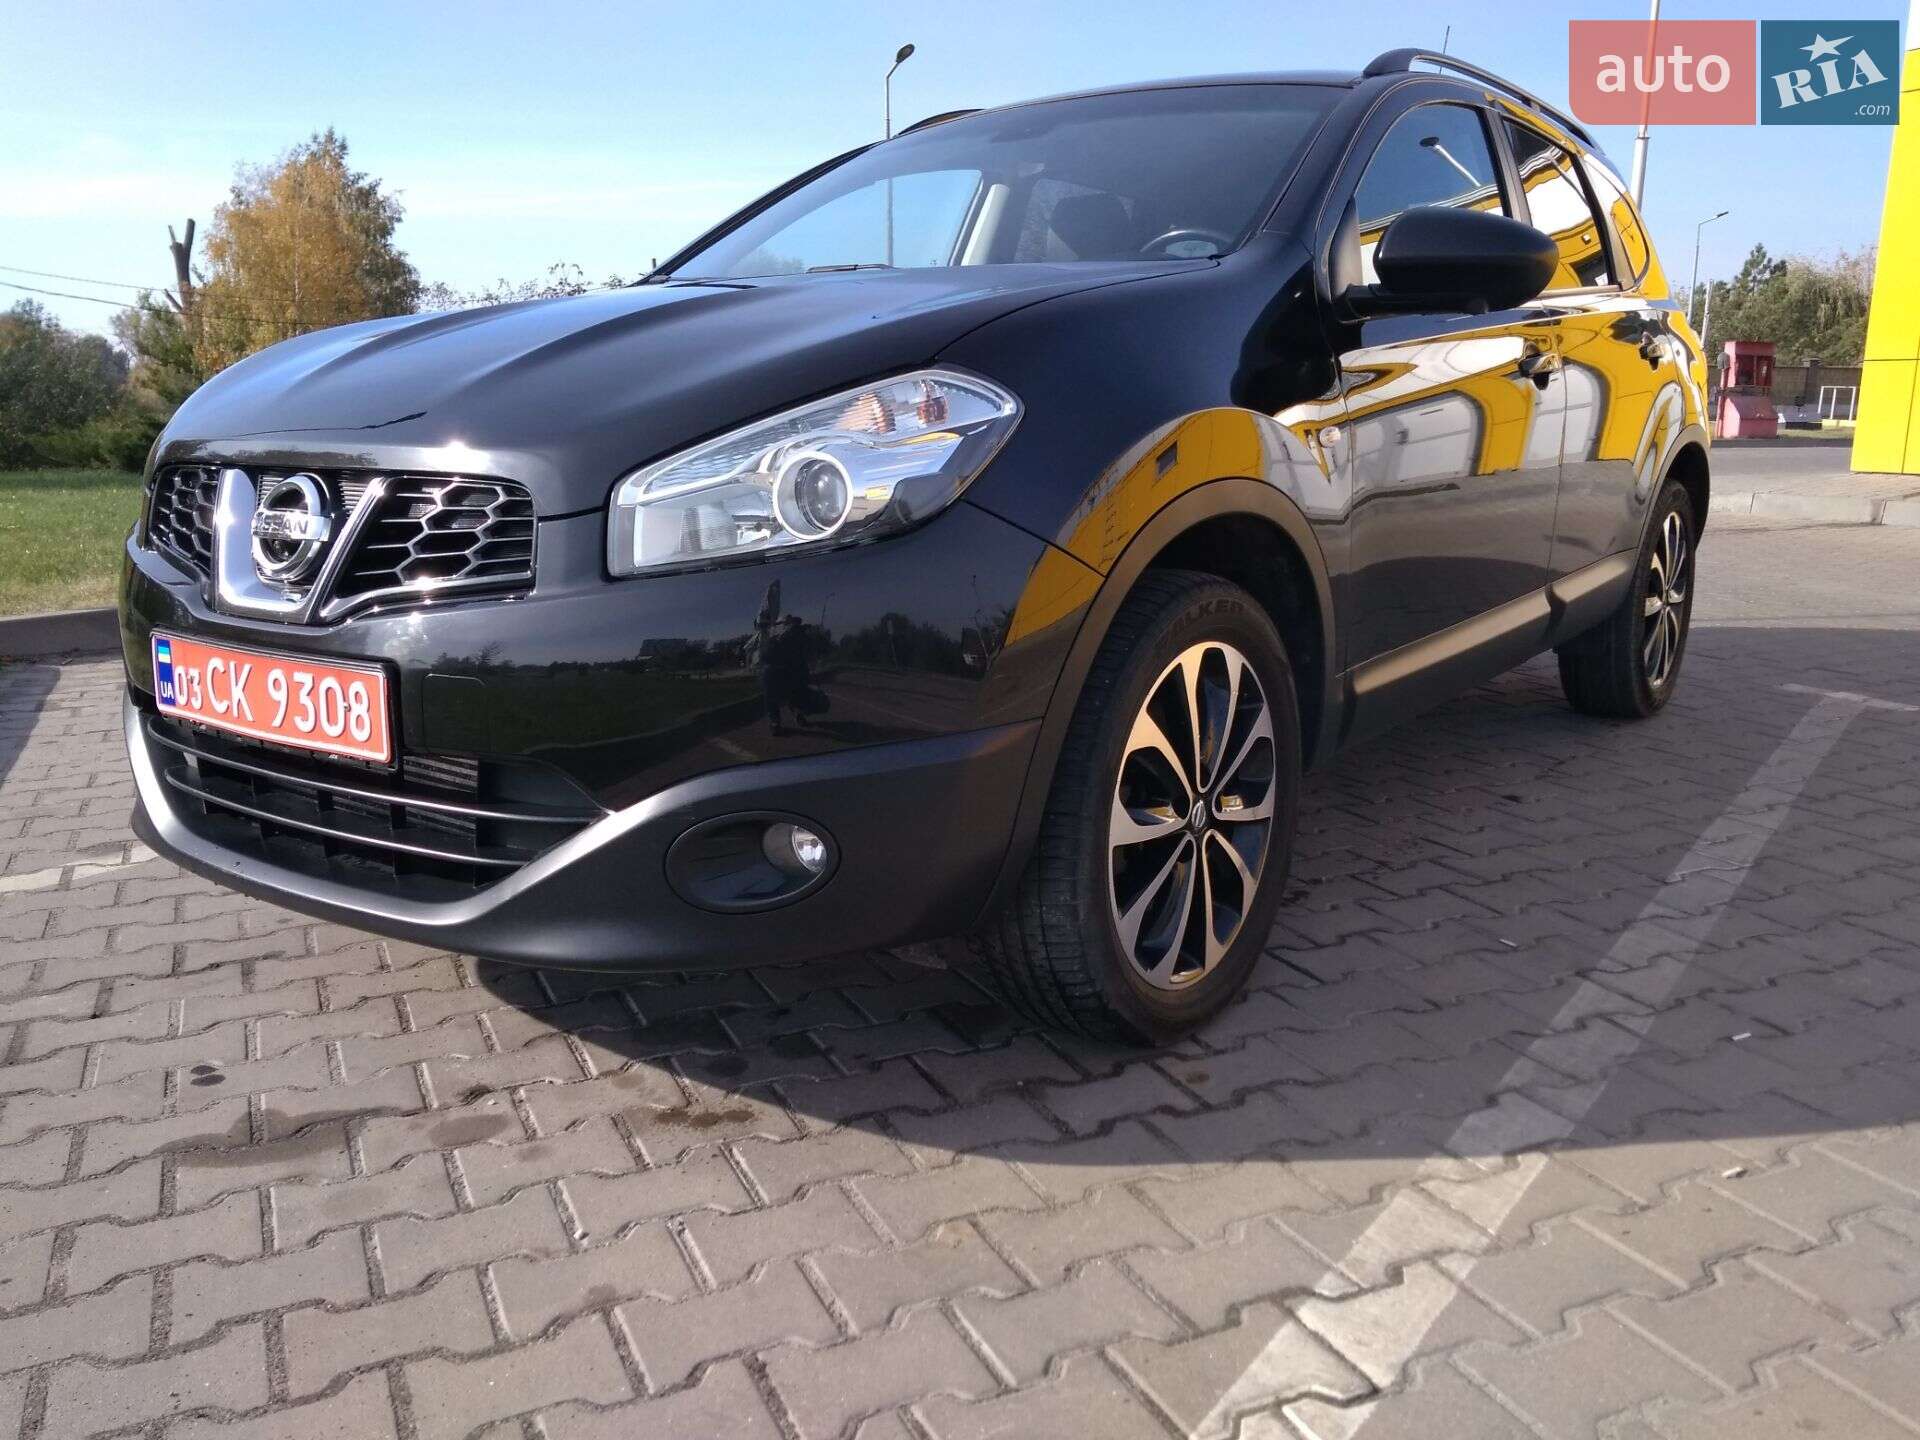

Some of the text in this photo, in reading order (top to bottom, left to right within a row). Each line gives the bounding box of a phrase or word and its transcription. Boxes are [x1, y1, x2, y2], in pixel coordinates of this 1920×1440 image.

[160, 680, 174, 699] UA
[175, 656, 371, 742] 03 CK 9308
